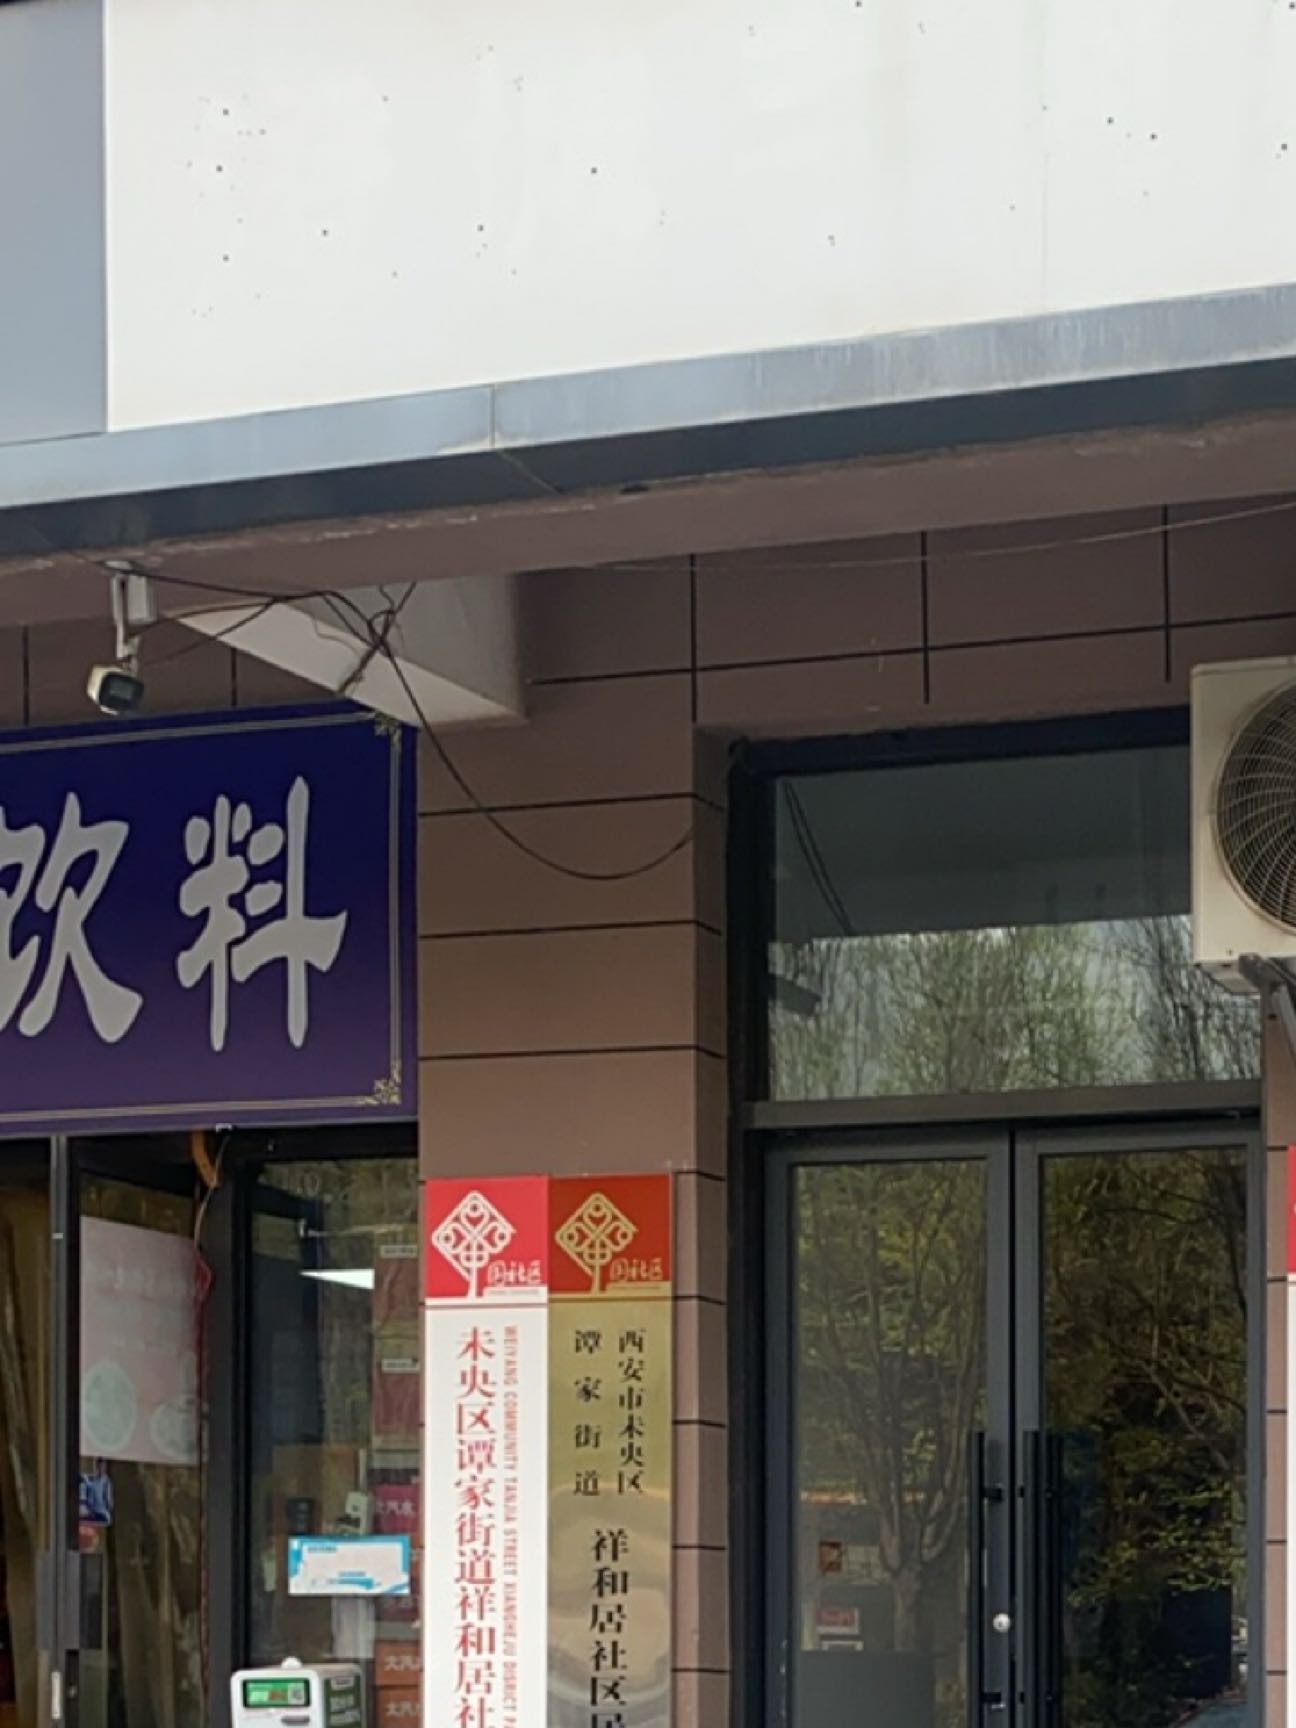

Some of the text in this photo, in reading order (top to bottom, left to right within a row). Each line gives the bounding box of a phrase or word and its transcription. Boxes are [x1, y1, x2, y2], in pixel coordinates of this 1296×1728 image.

[0, 774, 348, 1052] 饮料
[503, 1325, 519, 1386] WEIYANG
[503, 1390, 519, 1471] COMMUNITY
[574, 1330, 601, 1496] 谭家街道
[618, 1329, 646, 1495] 西安市未央区
[503, 1477, 519, 1523] TANJIA
[503, 1528, 519, 1576] STREET
